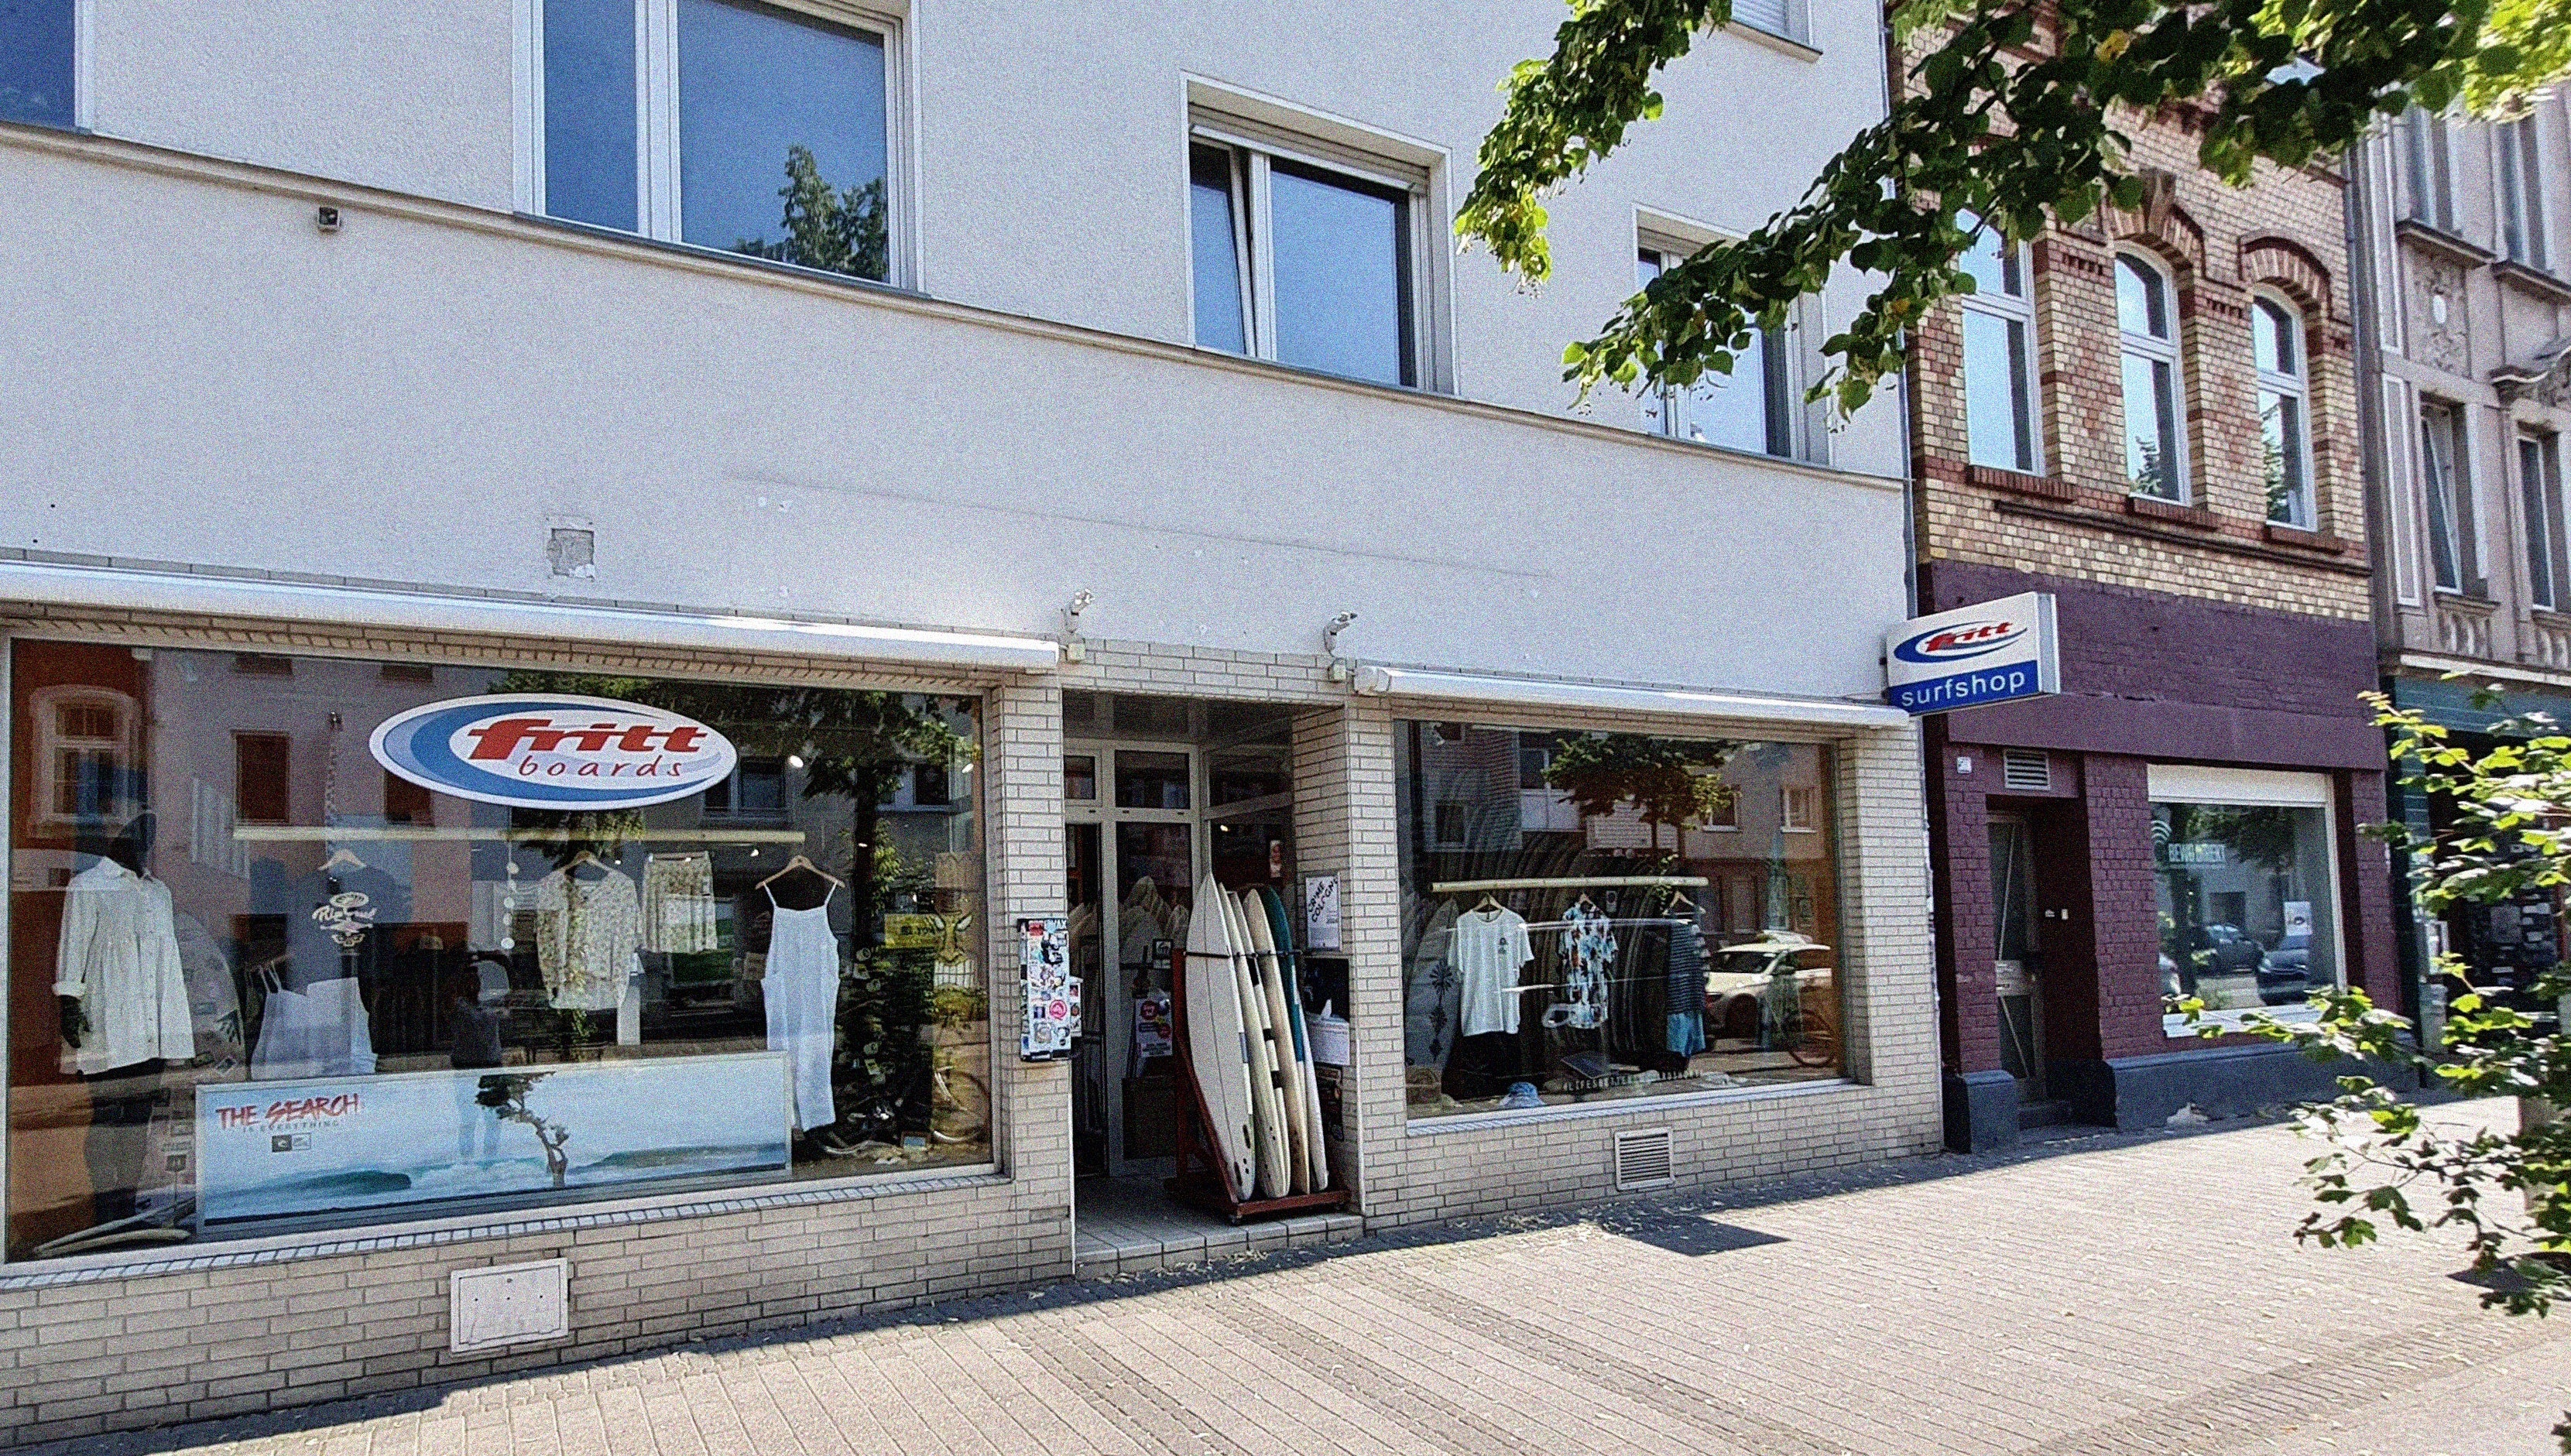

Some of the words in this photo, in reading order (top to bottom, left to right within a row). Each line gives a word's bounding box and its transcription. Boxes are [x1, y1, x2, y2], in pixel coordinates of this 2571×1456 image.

[1925, 622, 2013, 652] fritt
[1901, 671, 2025, 706] surfshop
[468, 719, 708, 759] fritt
[519, 755, 682, 776] boards
[215, 1105, 260, 1129] THE
[265, 1093, 358, 1129] SEARCH
